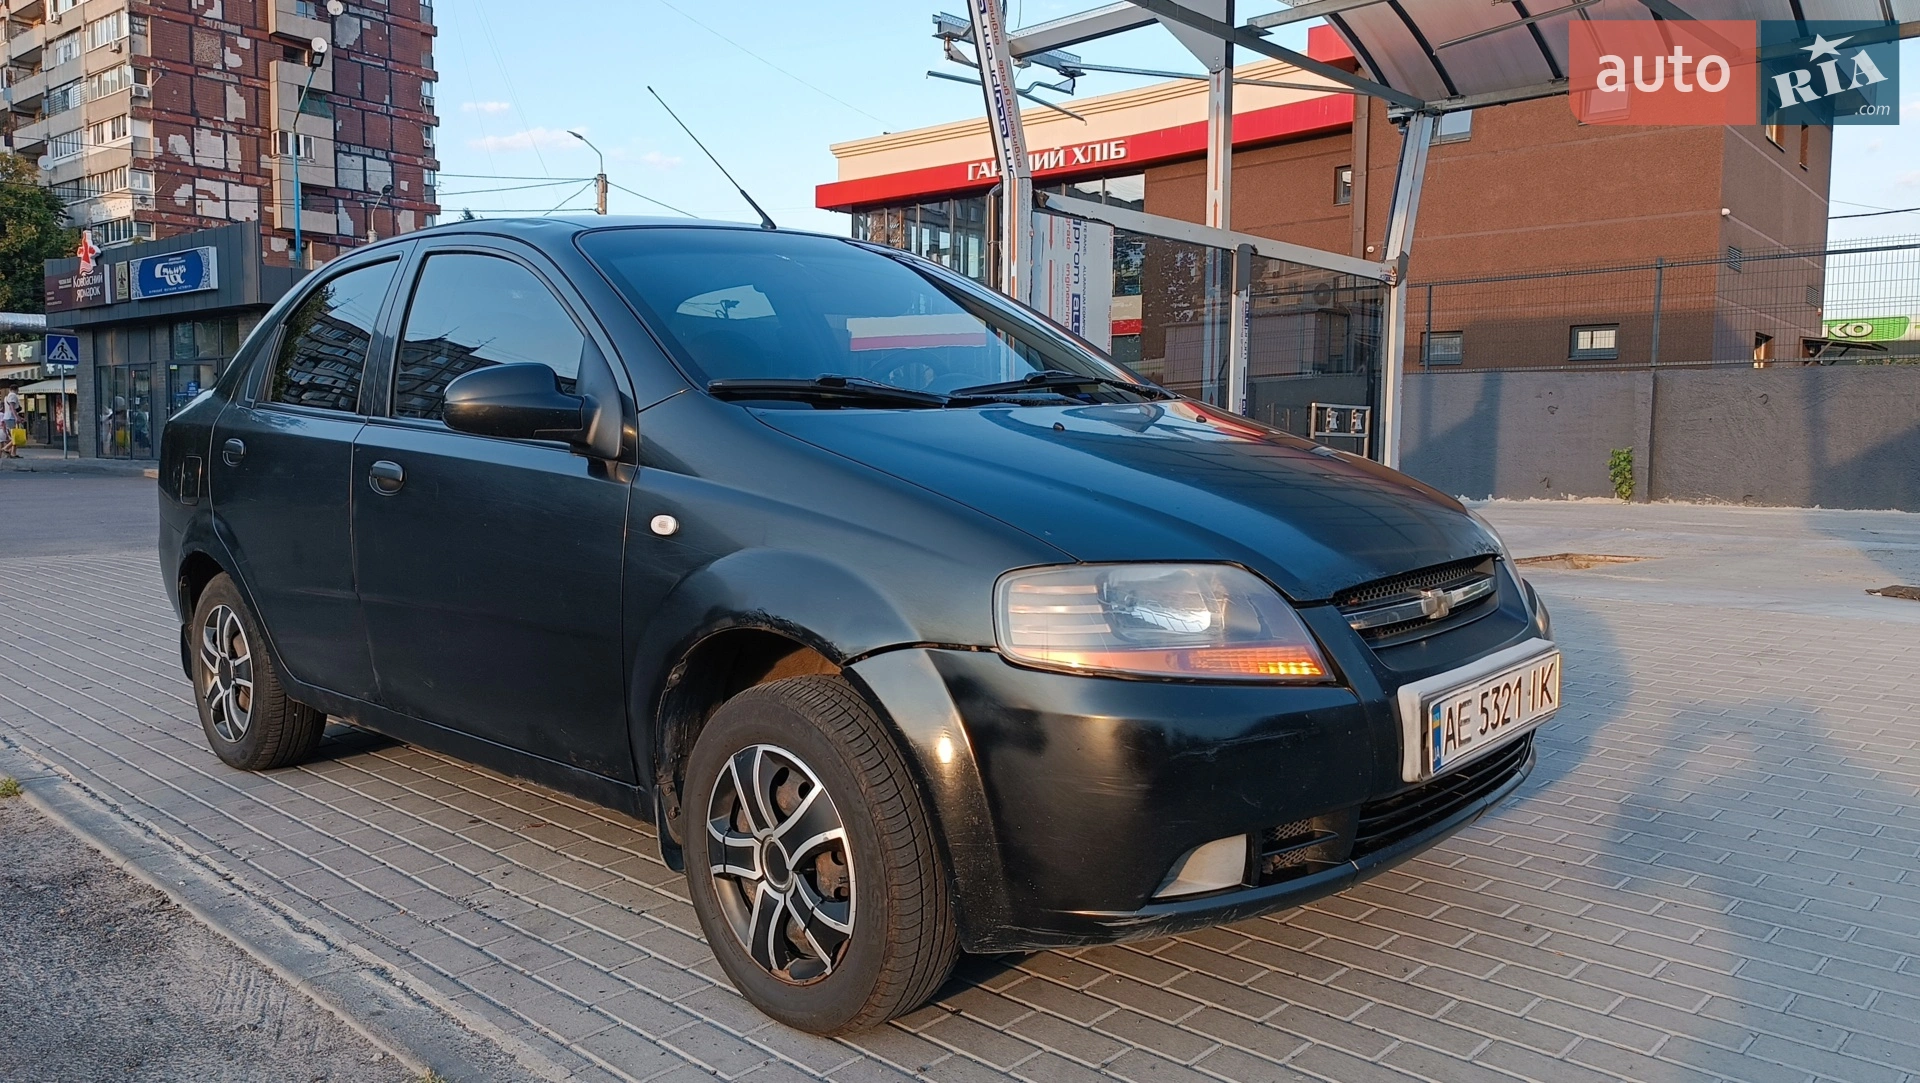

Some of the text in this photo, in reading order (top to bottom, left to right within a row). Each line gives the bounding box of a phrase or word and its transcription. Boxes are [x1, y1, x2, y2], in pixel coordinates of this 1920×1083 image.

[1072, 139, 1128, 165] ХЛІБ
[1442, 662, 1555, 757] AE 5321 IK
